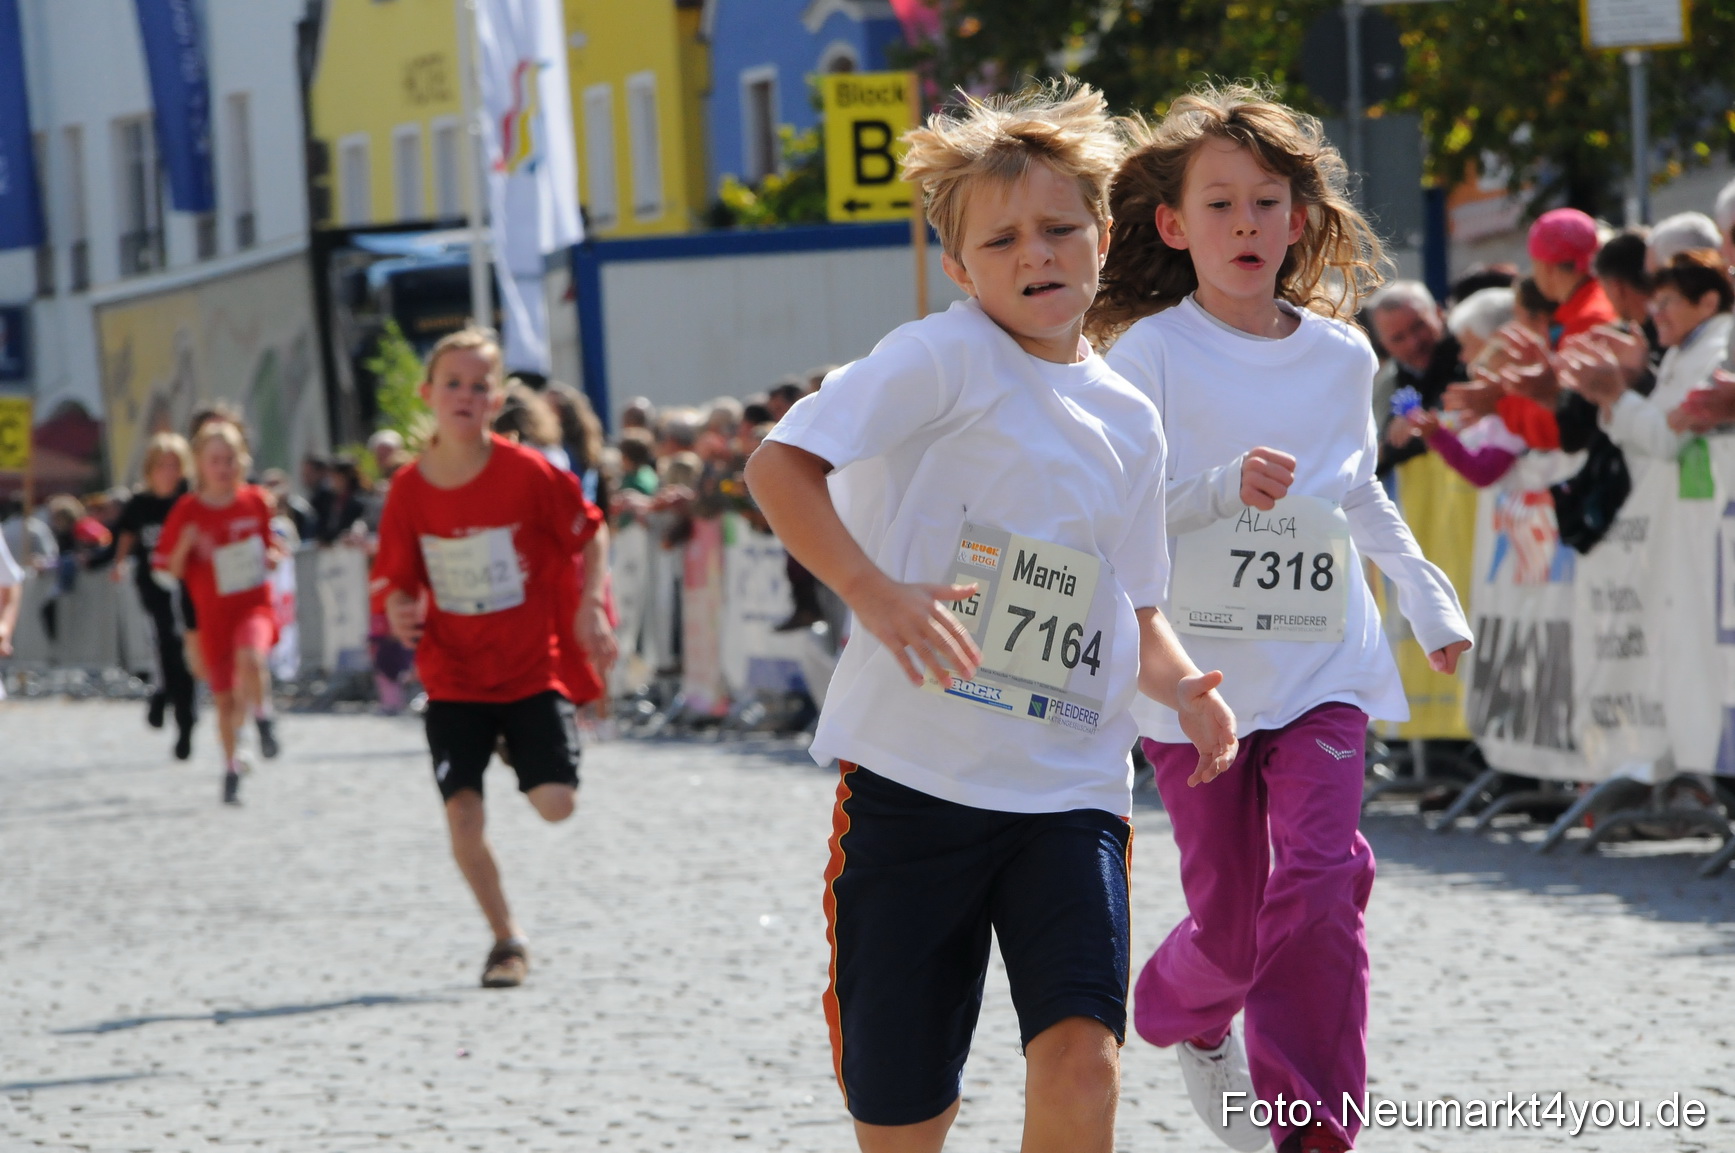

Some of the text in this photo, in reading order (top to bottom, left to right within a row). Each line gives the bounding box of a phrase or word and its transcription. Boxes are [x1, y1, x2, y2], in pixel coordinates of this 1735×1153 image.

[836, 82, 904, 107] Block
[853, 120, 896, 186] B
[1013, 550, 1077, 597] Maria
[1230, 549, 1334, 591] 7318
[1189, 610, 1233, 624] BOCK
[1273, 614, 1327, 626] PFLEIDERER
[1004, 604, 1102, 676] 7164
[949, 677, 1002, 700] BOCK
[1049, 699, 1099, 727] PFLEIDERER
